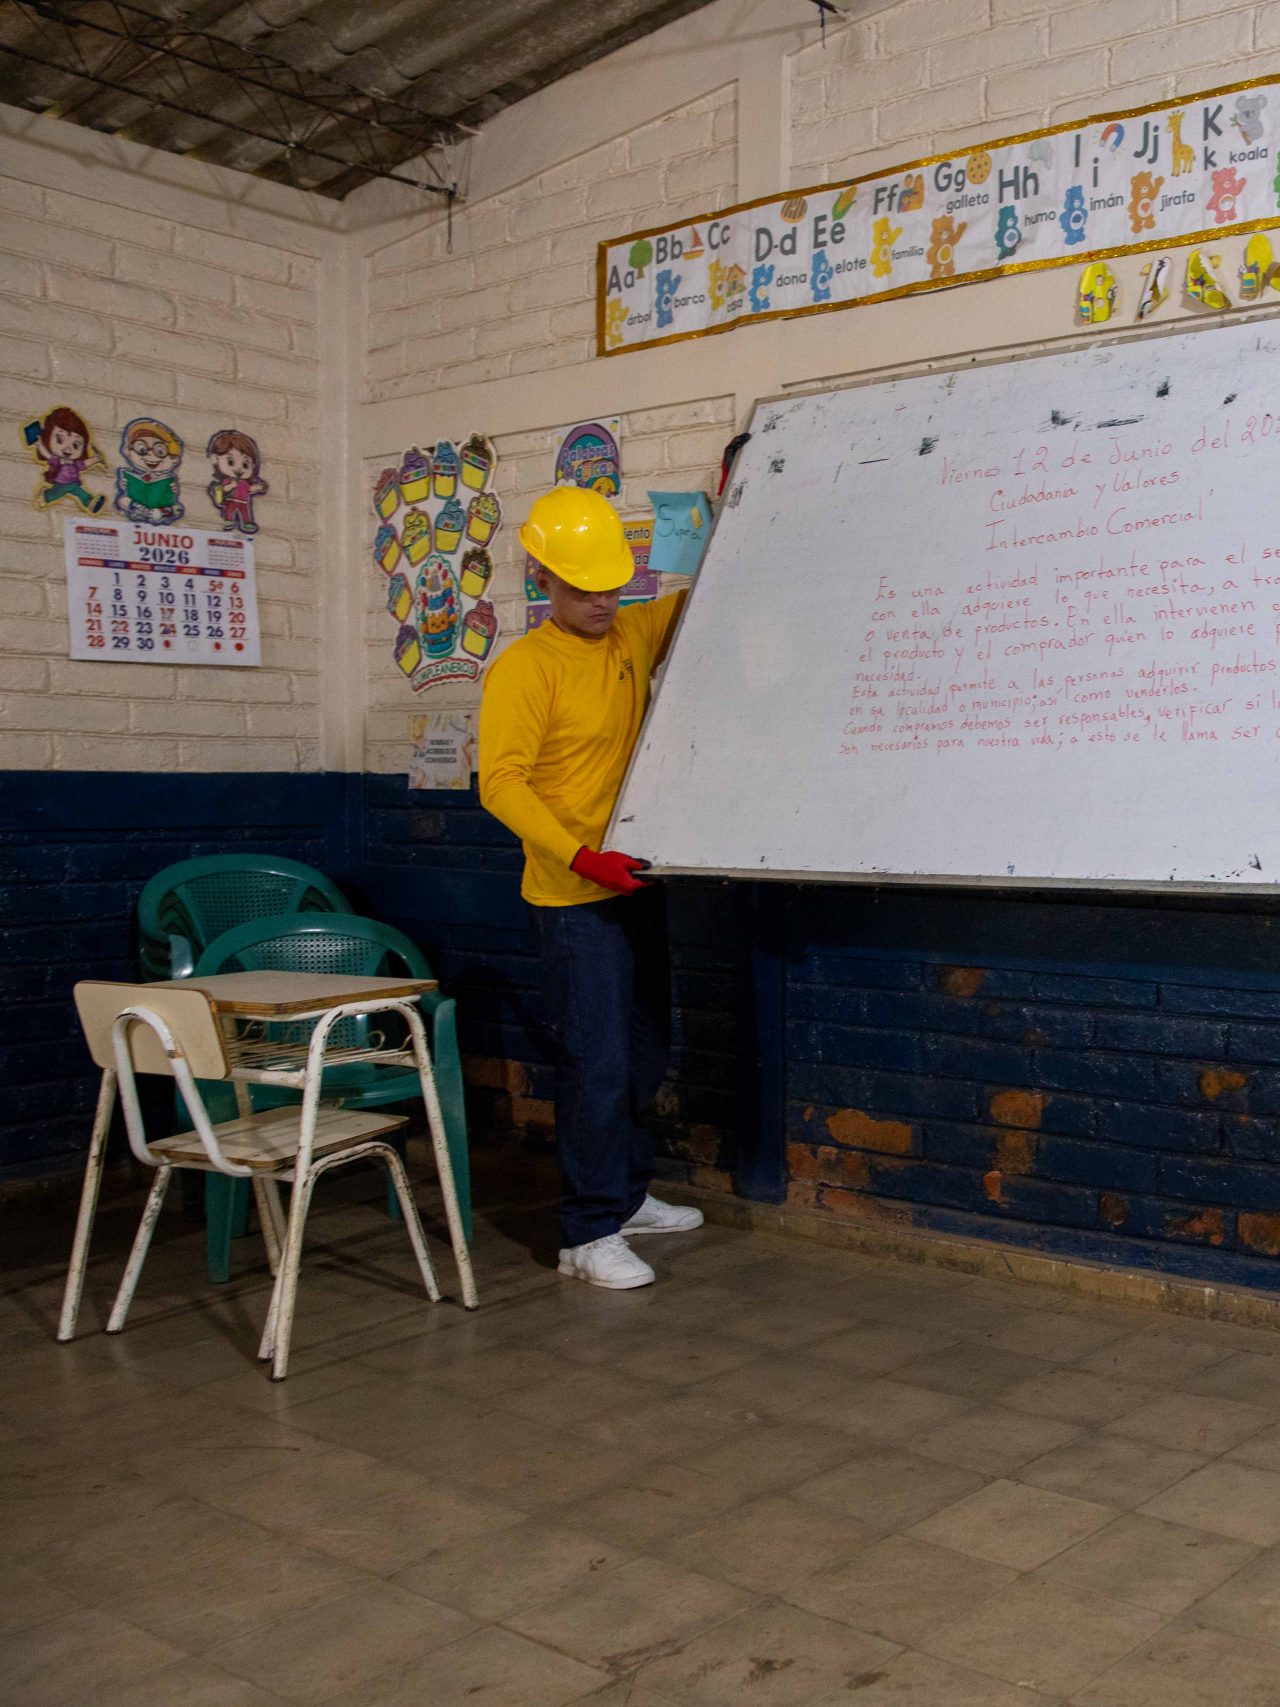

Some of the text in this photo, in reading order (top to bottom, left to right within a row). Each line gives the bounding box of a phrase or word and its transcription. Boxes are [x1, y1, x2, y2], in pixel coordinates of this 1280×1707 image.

[1203, 103, 1224, 141] K
[1074, 134, 1081, 168] I
[1133, 120, 1159, 164] Jj
[1229, 146, 1268, 164] koala
[1092, 157, 1099, 188] i
[1203, 145, 1218, 171] k
[934, 161, 967, 193] Gg
[998, 165, 1040, 204] Hh
[873, 183, 899, 215] Ff
[946, 192, 989, 214] galleta
[1090, 192, 1124, 211] imán
[1159, 191, 1195, 212] jirafa
[813, 214, 846, 250] Ee
[1024, 209, 1057, 227] humo
[656, 234, 683, 265] Bb
[708, 221, 731, 250] Cc
[835, 256, 867, 275] elote
[891, 245, 924, 261] familia
[607, 265, 636, 296] Aa
[776, 271, 807, 288] dona
[673, 293, 705, 309] barco
[627, 310, 652, 326] árbol
[941, 452, 1000, 485] Viernes
[1013, 447, 1049, 476] 12
[1061, 440, 1092, 468] de
[1108, 435, 1173, 465] Junio
[1191, 419, 1230, 452] del
[1094, 484, 1107, 510] y
[1112, 469, 1180, 492] Valores
[624, 528, 651, 540] iento
[985, 497, 1203, 551] Intercambio Comercial
[133, 530, 194, 550] JUNIO
[139, 546, 190, 565] 2026
[875, 576, 897, 601] Es
[912, 586, 944, 598] una
[965, 564, 1038, 594] actividad
[1055, 549, 1151, 590] importante
[1160, 557, 1206, 582] para
[1225, 543, 1247, 564] el
[86, 602, 246, 624] 14 15 16 18 19 20
[159, 591, 244, 609] 10 11 12 13
[872, 610, 896, 621] con
[911, 600, 943, 618] ella
[1056, 588, 1069, 605] lo
[1083, 590, 1110, 613] que
[1222, 580, 1239, 590] a
[86, 619, 246, 640] 21 23 25 26 27
[886, 624, 932, 642] venta
[943, 620, 964, 638] de
[1067, 605, 1090, 628] En
[1103, 602, 1137, 625] ella
[1154, 599, 1256, 622] intervienen
[87, 635, 154, 650] 28 29 30
[859, 647, 872, 662] el
[883, 640, 945, 671] producto
[954, 647, 965, 674] y
[976, 640, 991, 661] el
[1004, 628, 1096, 663] comprador
[1104, 630, 1147, 657] quien
[1161, 624, 1174, 640] lo
[1190, 620, 1257, 649] adquiere
[852, 683, 879, 698] Esta
[949, 667, 996, 701] permite
[1008, 679, 1019, 690] a
[1032, 668, 1055, 689] las
[1064, 666, 1125, 699] personas
[1211, 649, 1276, 687] productos
[870, 706, 885, 716] su
[1073, 690, 1112, 703] como
[1024, 715, 1049, 727] ser
[1246, 693, 1260, 710] si
[936, 738, 965, 756] para
[1070, 736, 1079, 744] a
[1088, 724, 1116, 742] esto
[1124, 732, 1142, 742] se
[1154, 723, 1168, 742] le
[1182, 720, 1219, 742] llama
[1232, 725, 1261, 740] ser
